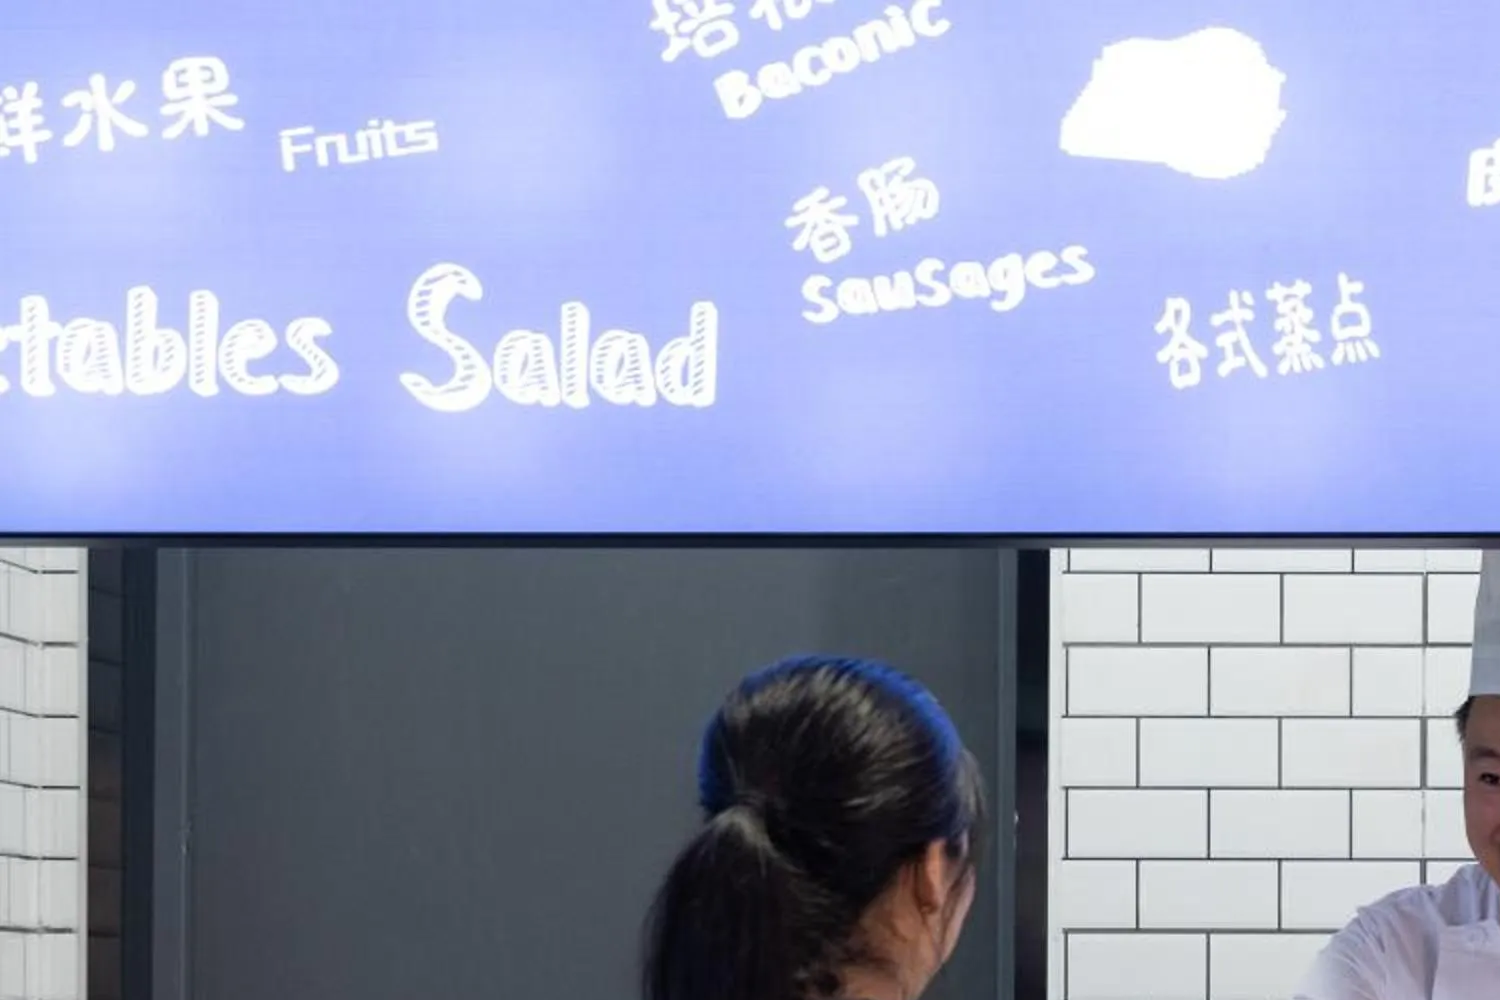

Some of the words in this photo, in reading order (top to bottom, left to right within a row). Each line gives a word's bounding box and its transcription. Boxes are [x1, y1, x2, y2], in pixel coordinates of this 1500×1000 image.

[713, 0, 952, 119] Baconic
[279, 119, 440, 171] Fruits
[784, 156, 940, 264] 香肠
[399, 262, 718, 412] Salad
[1154, 272, 1380, 389] 各式蒸点
